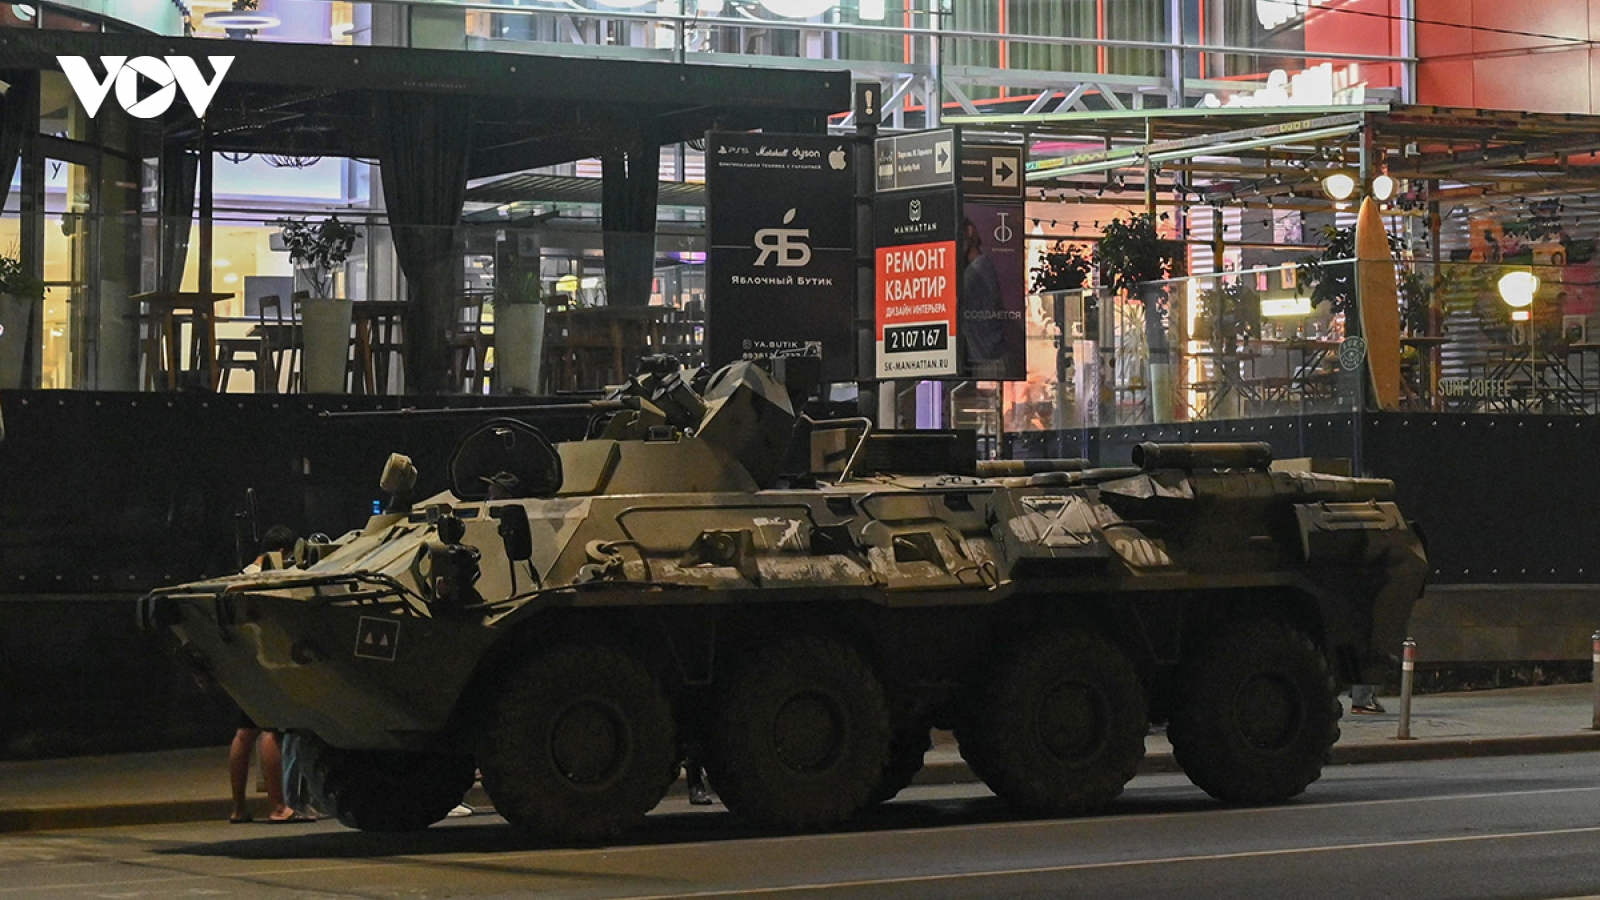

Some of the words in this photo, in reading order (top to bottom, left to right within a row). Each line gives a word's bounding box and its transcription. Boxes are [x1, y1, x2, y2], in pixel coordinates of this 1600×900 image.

[792, 147, 821, 160] dyson
[894, 222, 937, 235] MANHATTAN
[886, 247, 947, 274] РЕМОНТ
[885, 275, 947, 301] КВАРТИР
[885, 304, 912, 319] ДИЗАЙН
[754, 340, 798, 348] YA.BUTIK
[891, 331, 899, 349] 2
[900, 330, 919, 348] 107
[921, 328, 941, 346] 167
[884, 358, 949, 371] SK-MANHATTAN.RU
[1438, 379, 1467, 397] SURF
[1470, 379, 1511, 398] COFFEE
